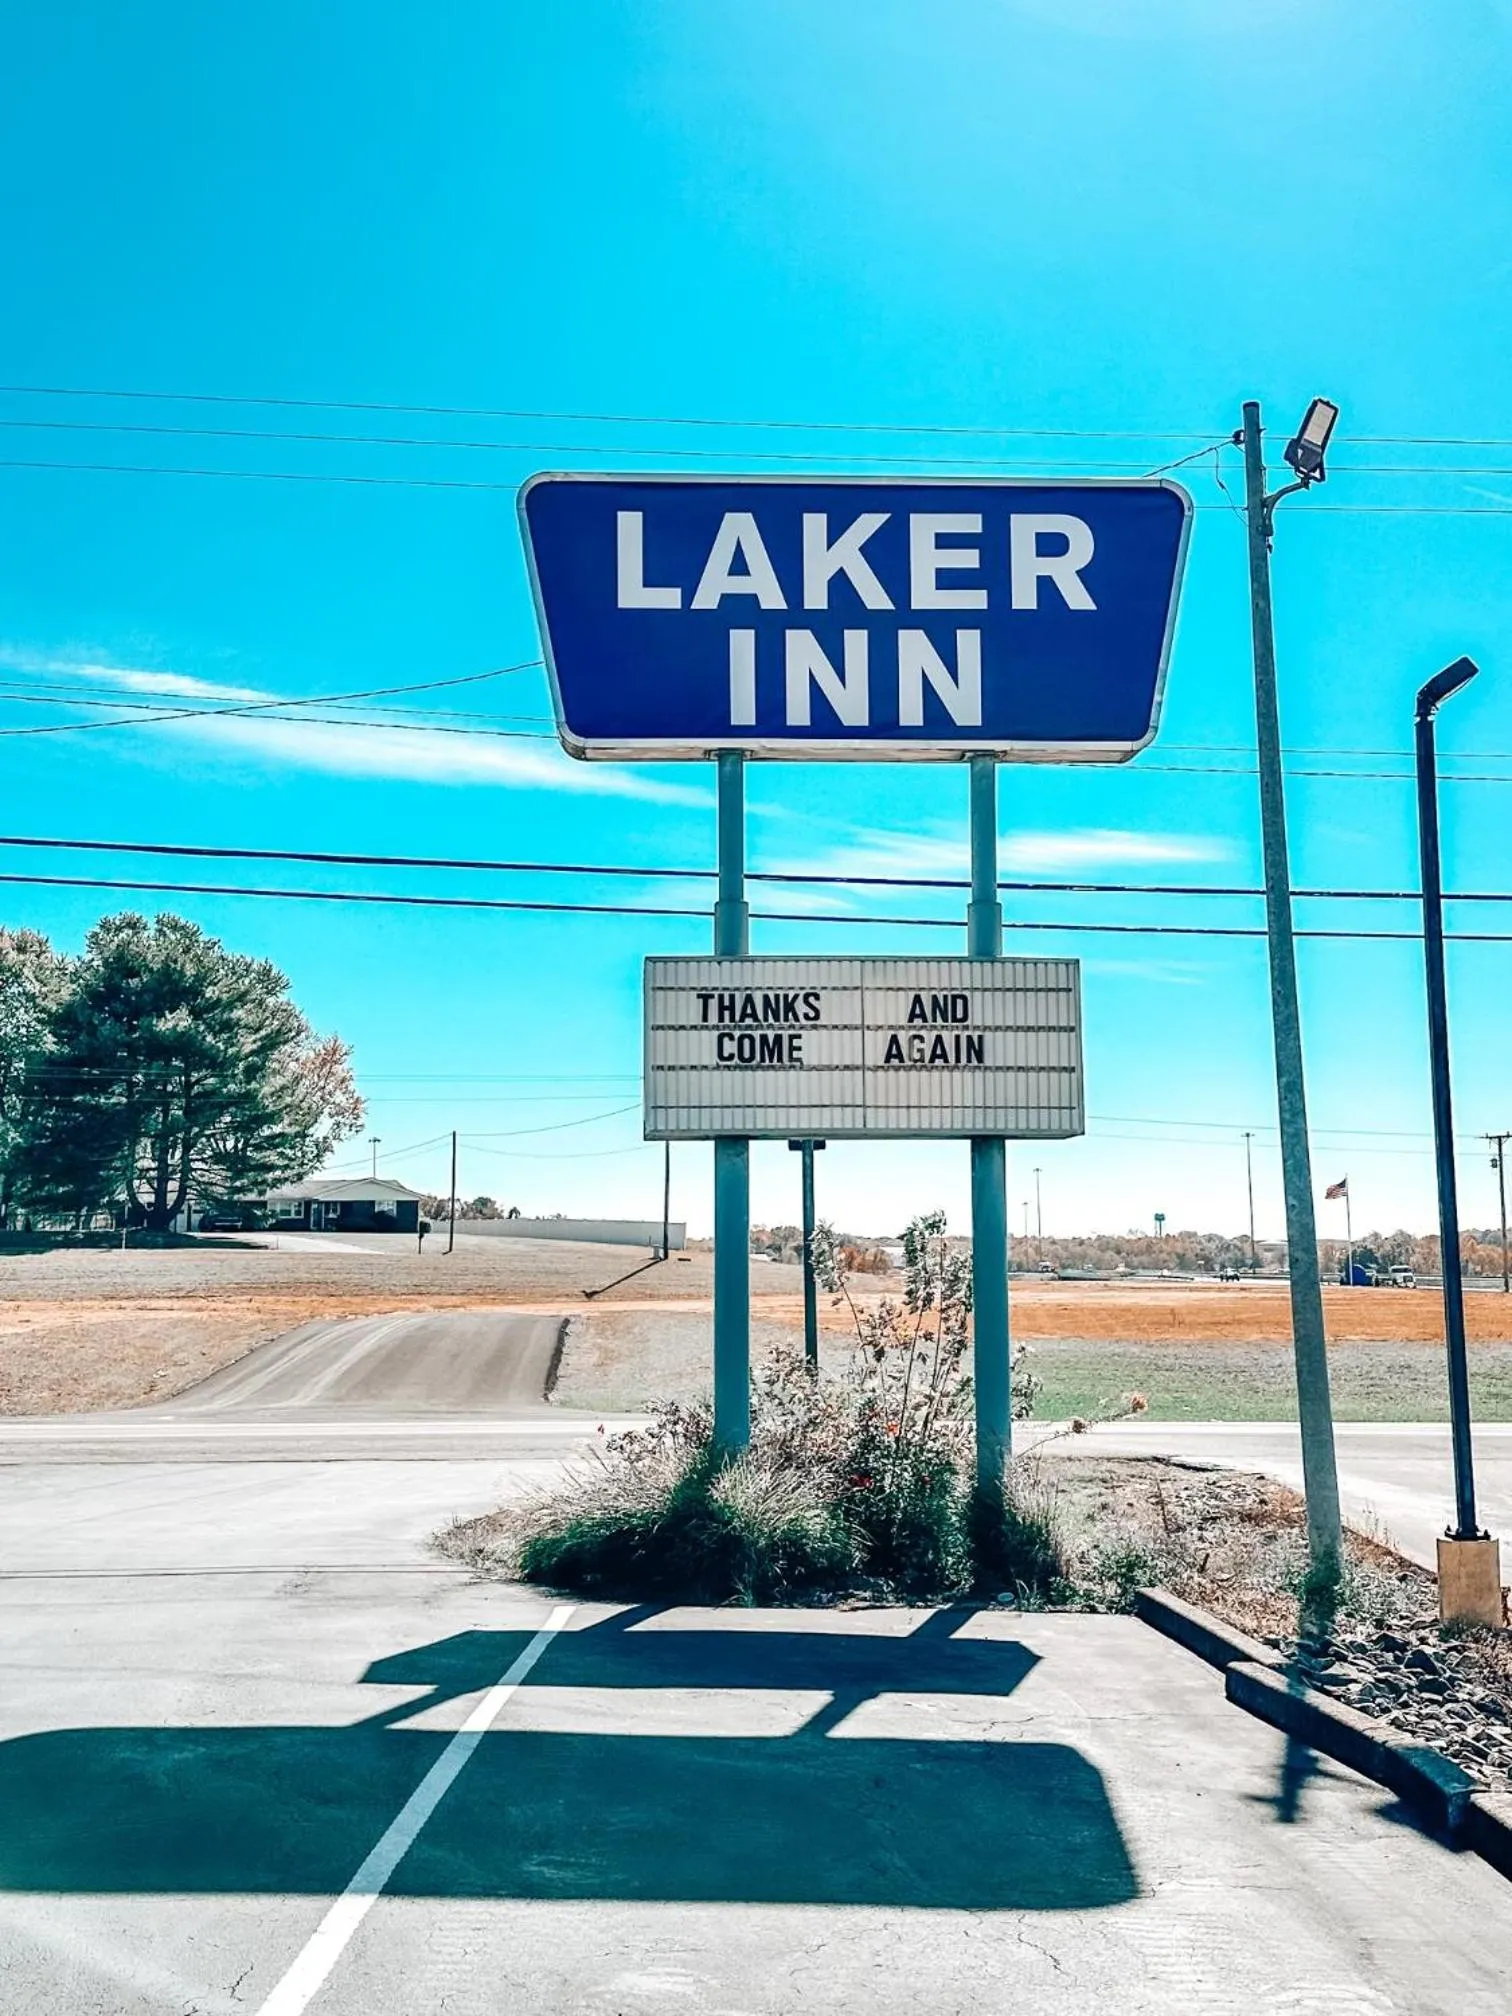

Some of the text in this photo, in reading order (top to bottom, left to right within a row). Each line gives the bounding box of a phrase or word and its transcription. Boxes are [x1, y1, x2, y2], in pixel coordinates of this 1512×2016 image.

[617, 511, 1097, 610] LAKER
[729, 629, 982, 727] INN
[697, 992, 969, 1024] THANKS AND
[717, 1032, 985, 1065] COME AGAIN
